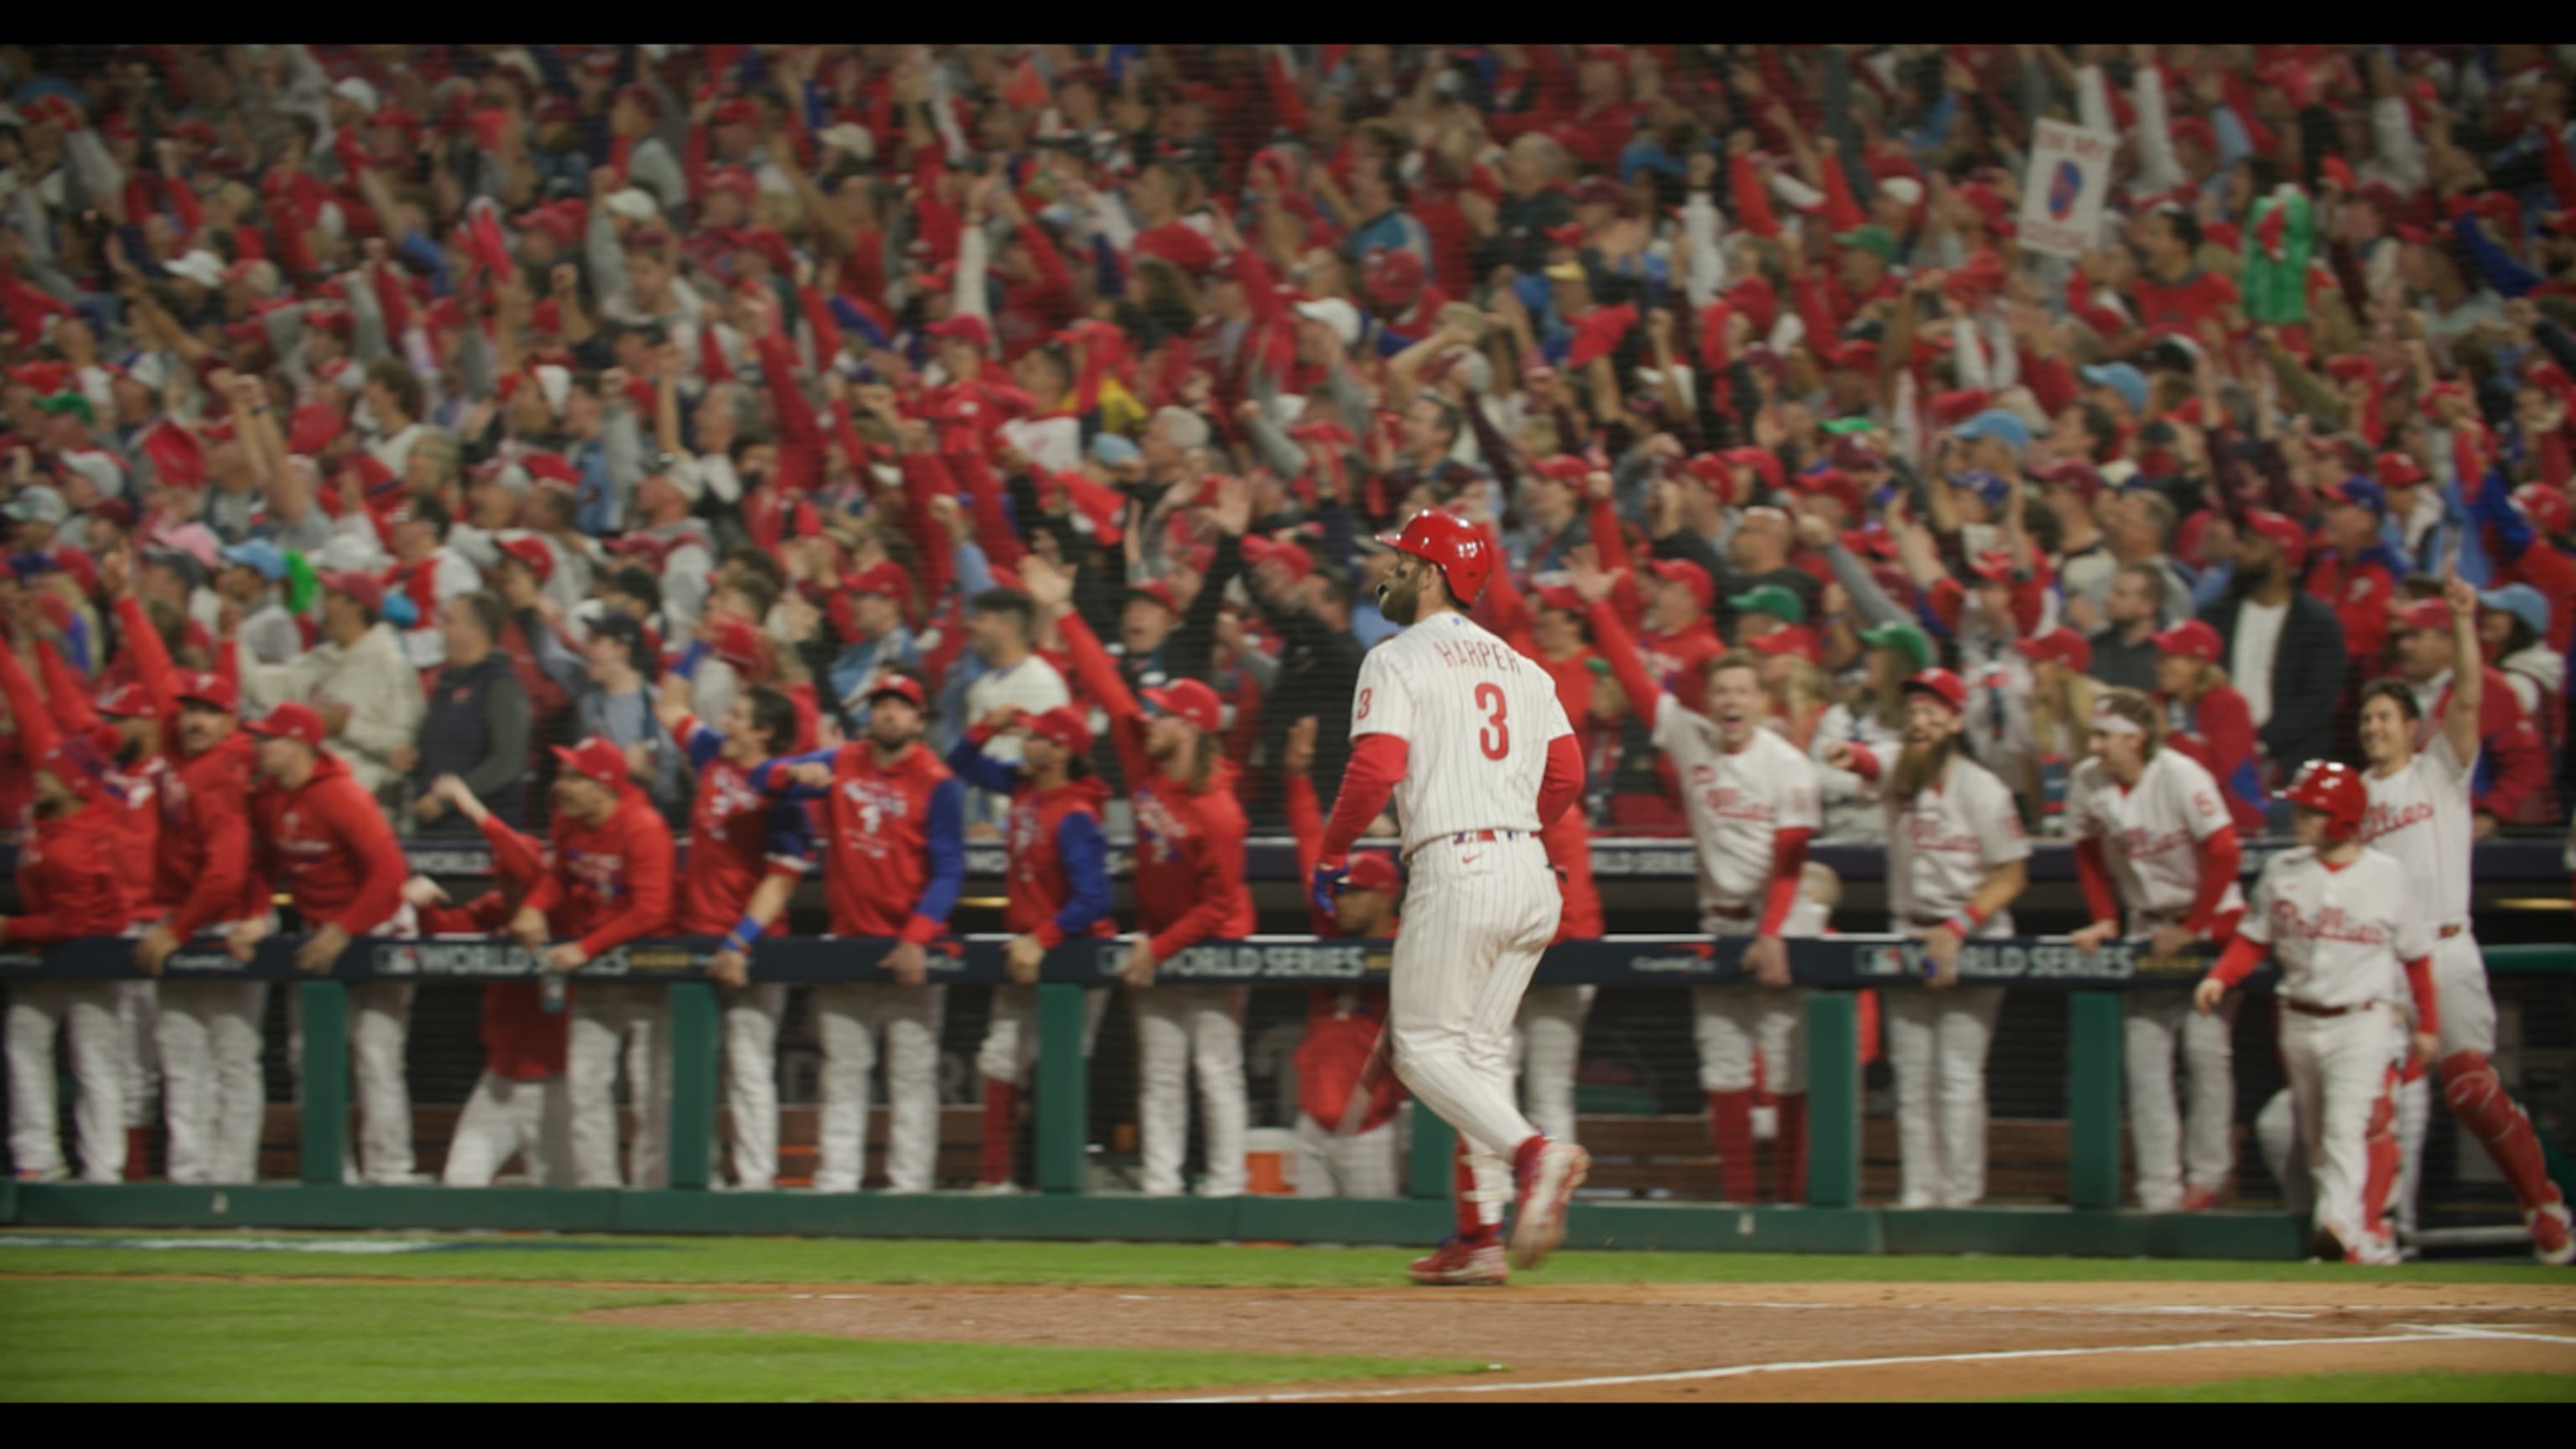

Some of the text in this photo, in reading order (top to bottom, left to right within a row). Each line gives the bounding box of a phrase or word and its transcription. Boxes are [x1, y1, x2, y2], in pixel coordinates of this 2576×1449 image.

[1433, 639, 1522, 674] HARPER
[1356, 686, 1373, 721] 3
[1474, 682, 1510, 761] 3
[421, 945, 532, 975] WORLD
[1164, 946, 1259, 977] ORLD
[1262, 945, 1366, 977] SERIES
[2028, 945, 2135, 979] SERIES
